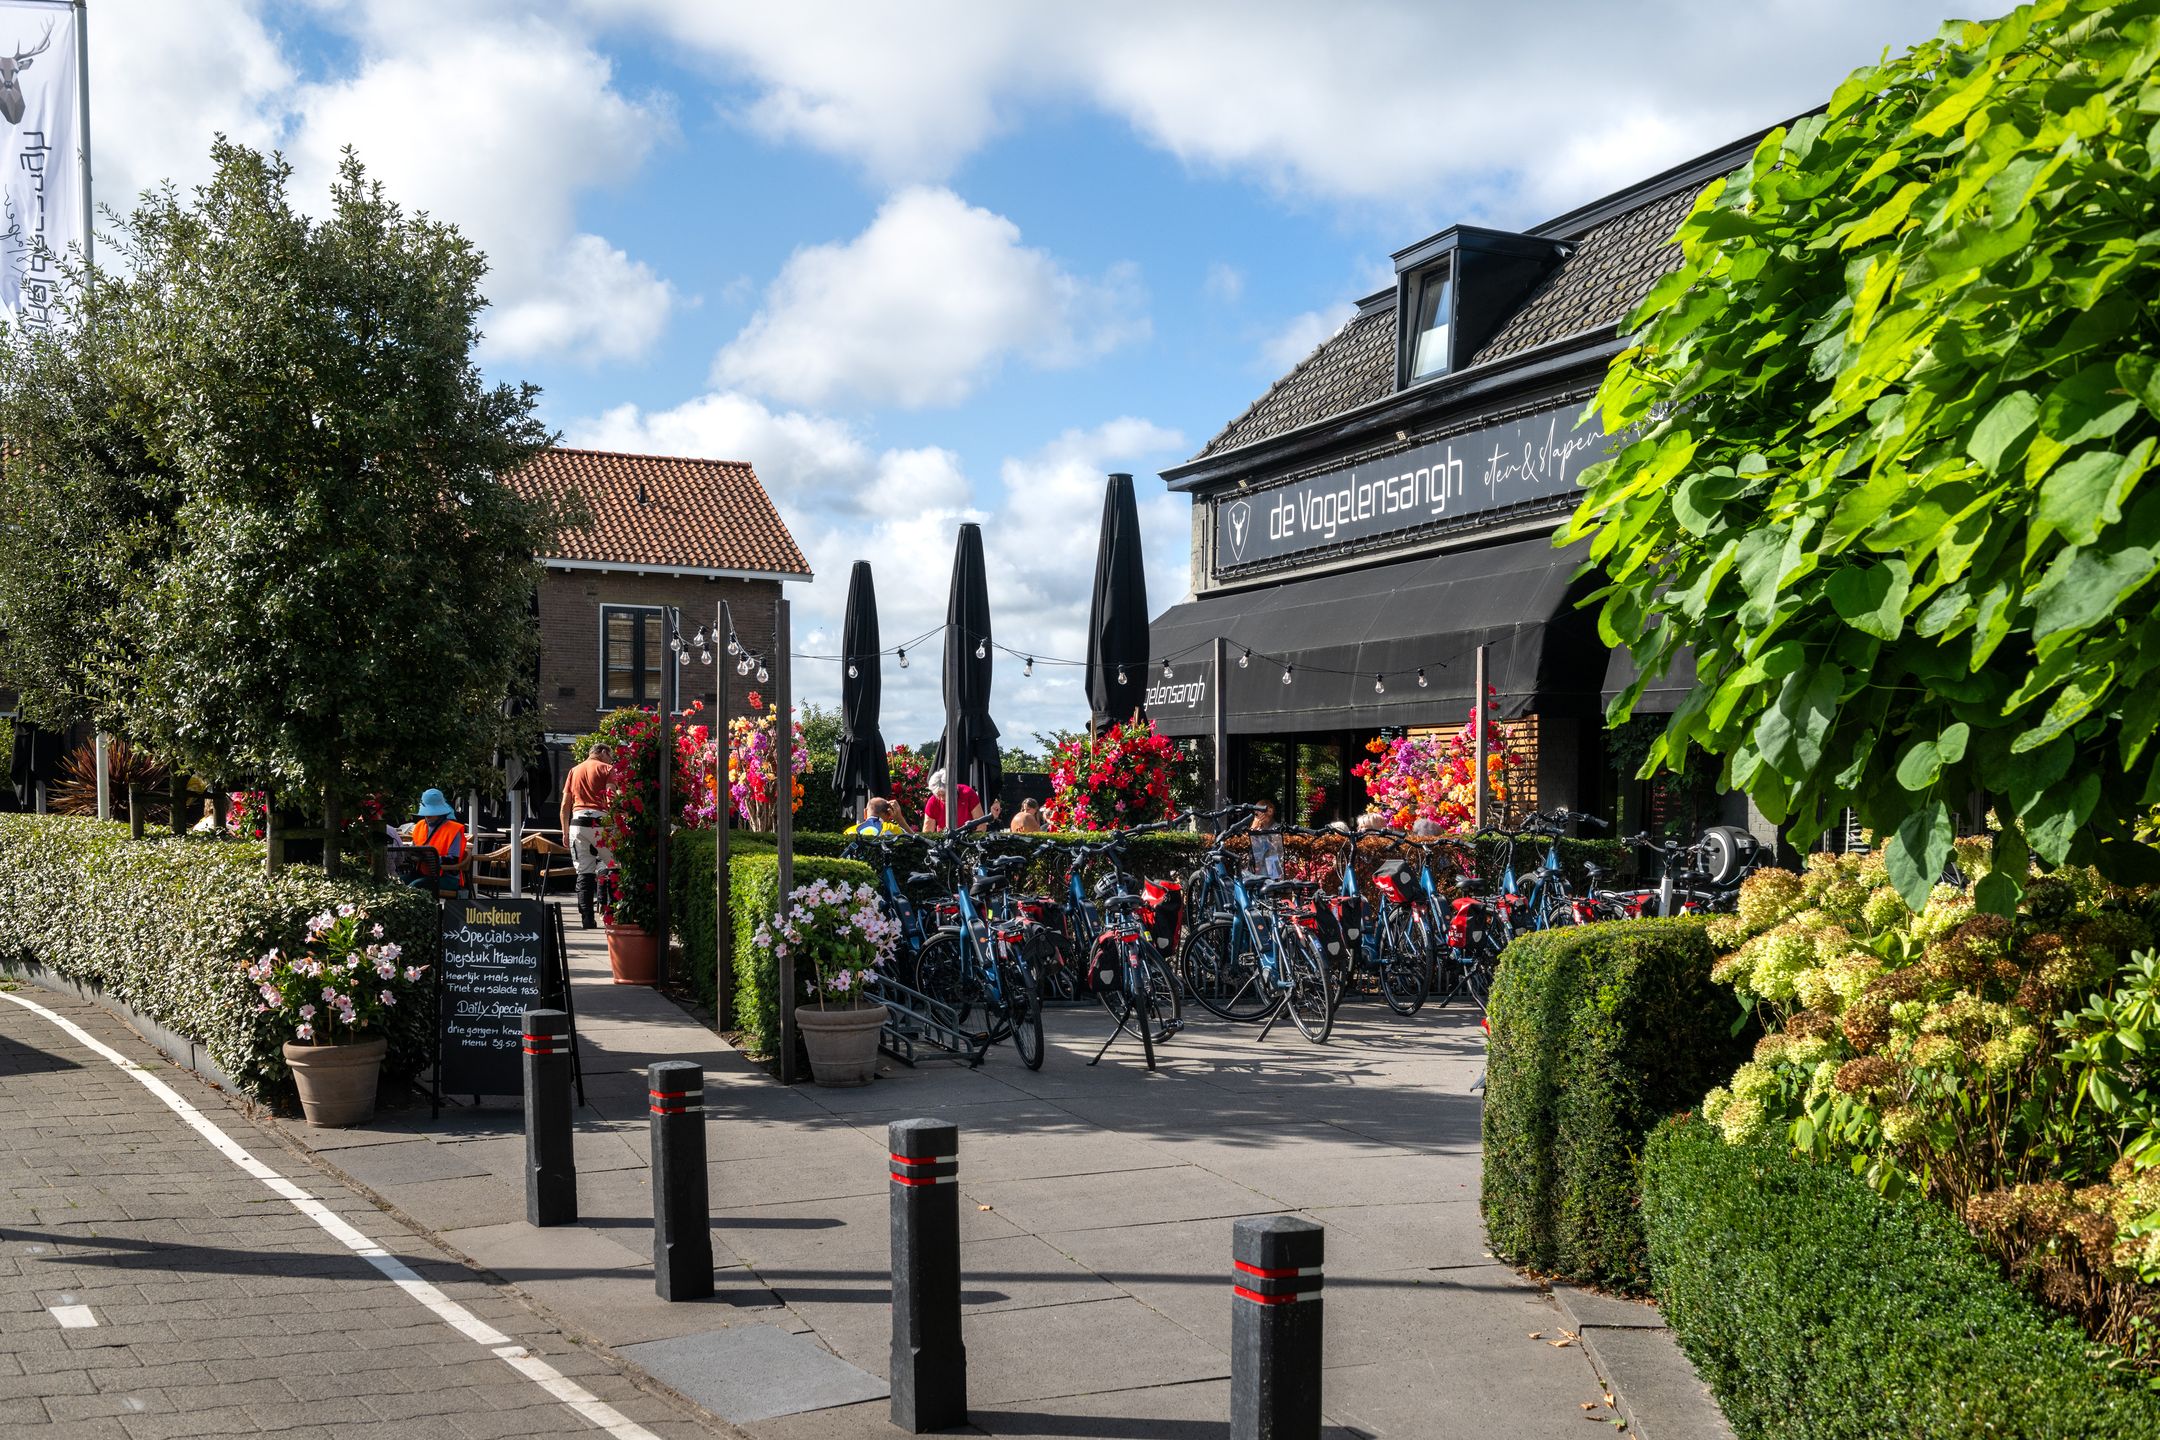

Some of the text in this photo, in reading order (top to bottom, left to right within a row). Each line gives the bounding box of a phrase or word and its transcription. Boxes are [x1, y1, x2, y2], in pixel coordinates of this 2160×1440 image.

[1270, 445, 1463, 540] de Vogelensangh
[465, 906, 522, 927] Warsteiner
[460, 925, 512, 947] Specials
[456, 1000, 527, 1022] Daily Special
[461, 1039, 487, 1047] menu
